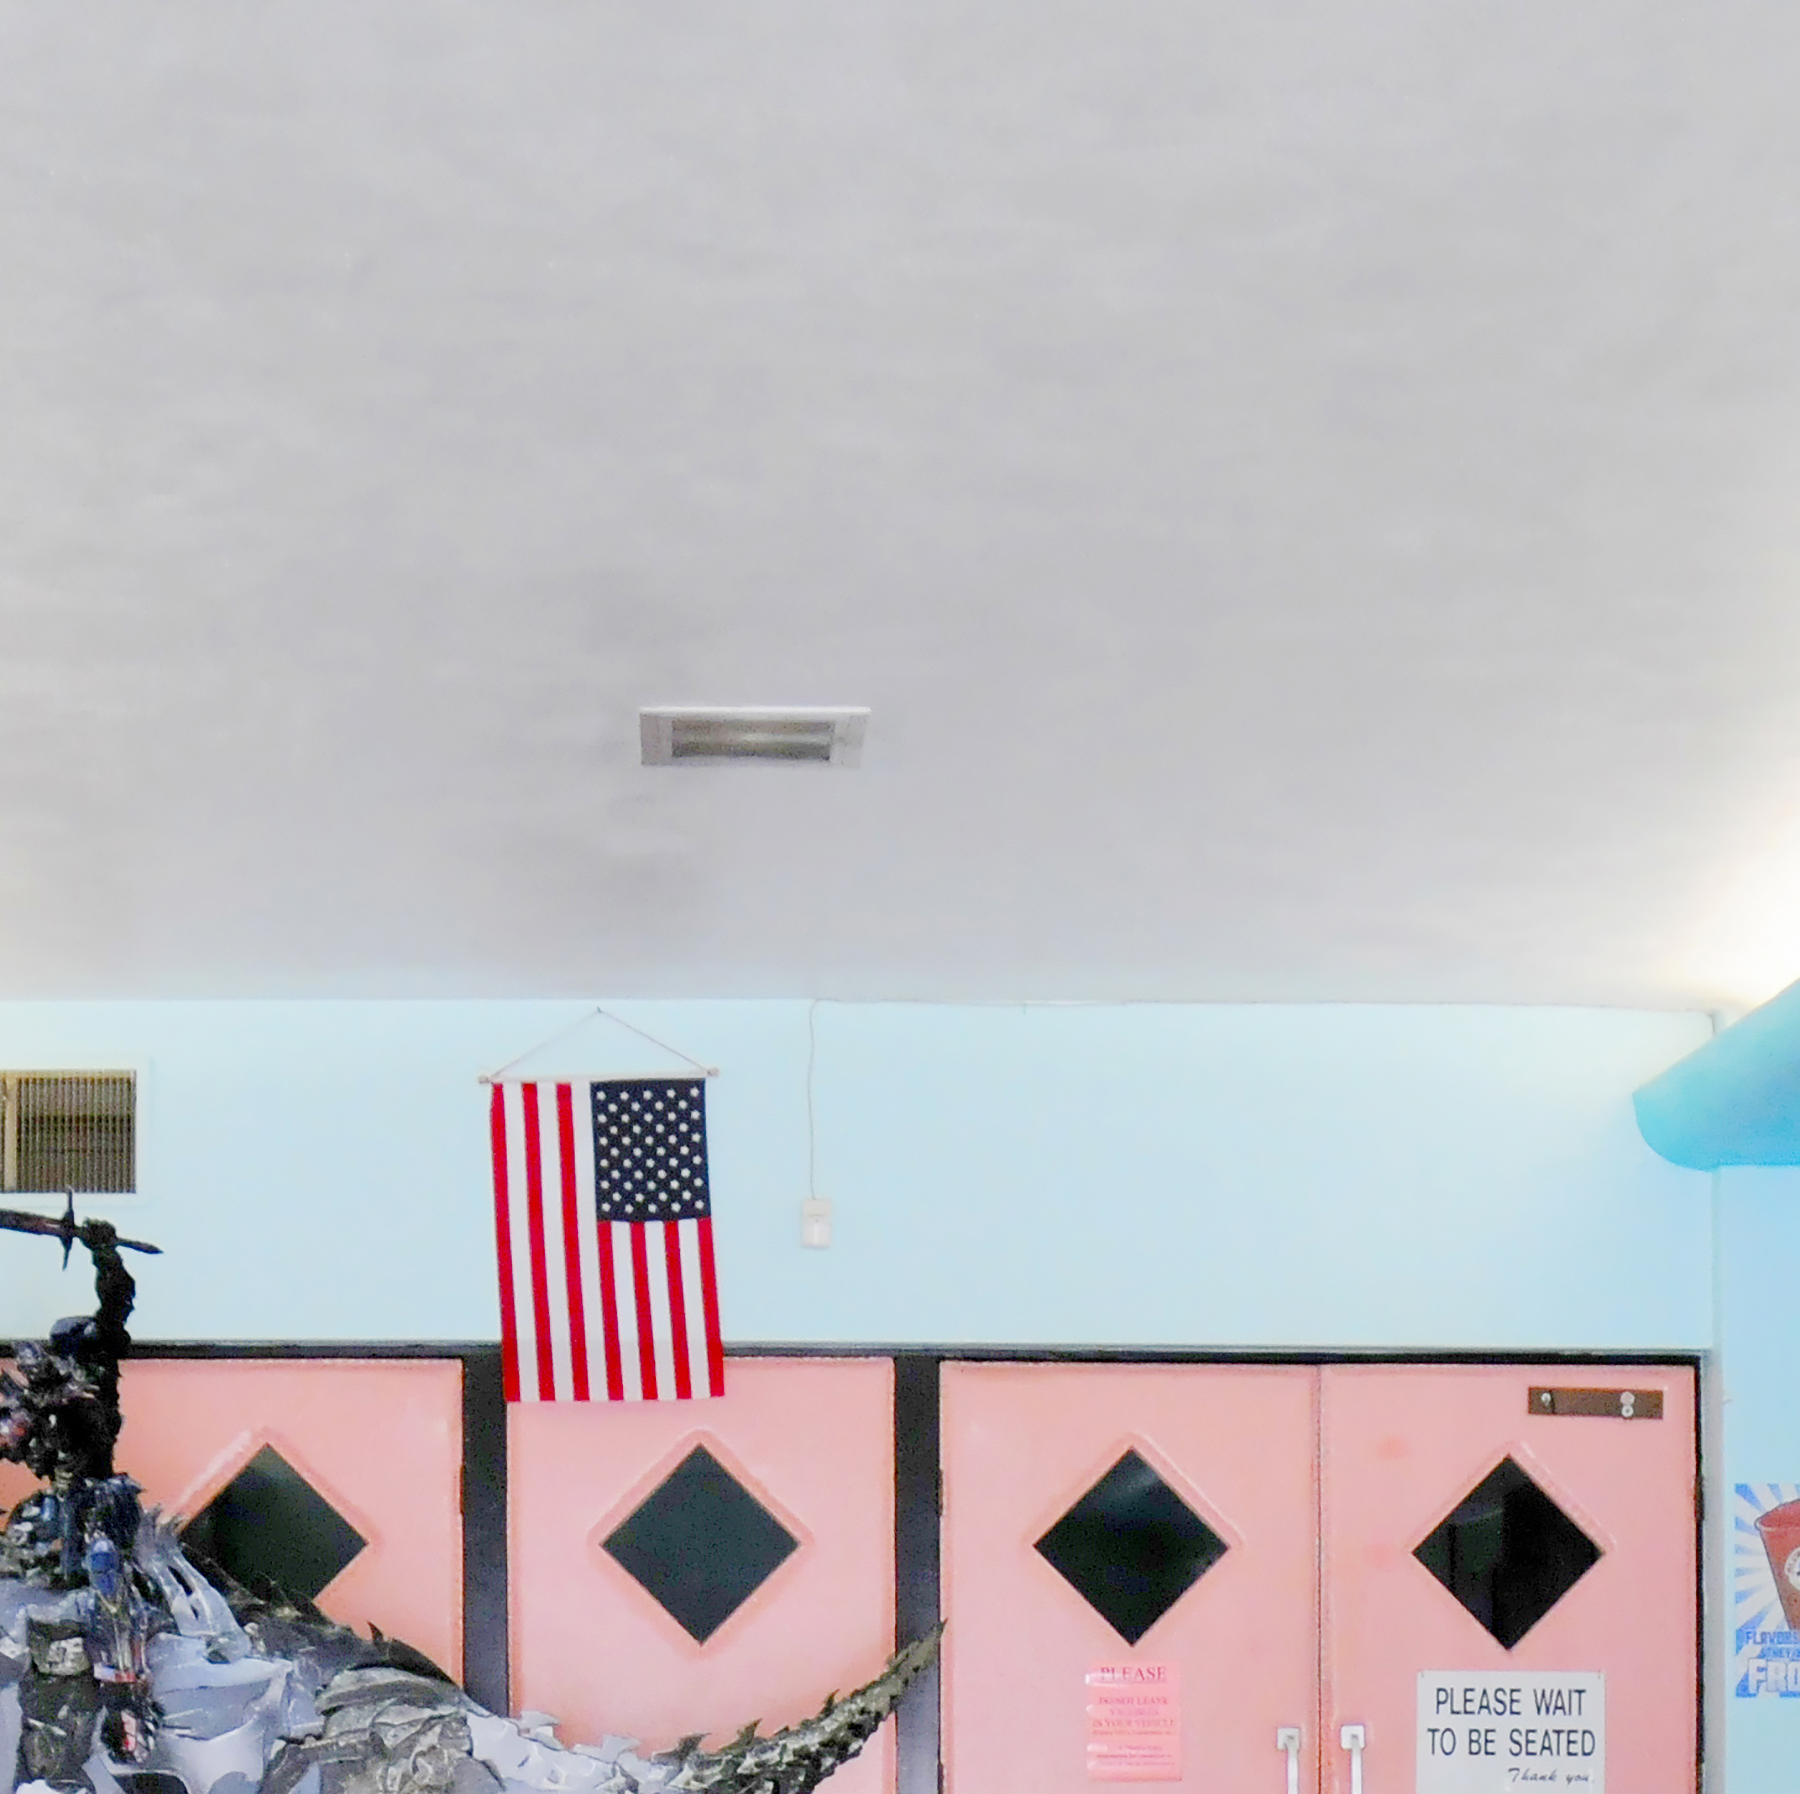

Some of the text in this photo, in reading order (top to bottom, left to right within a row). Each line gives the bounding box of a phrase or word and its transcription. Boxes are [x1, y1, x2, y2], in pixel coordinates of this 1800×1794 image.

[1100, 1666, 1167, 1682] PLEASE
[1435, 1687, 1587, 1716] PLEASE WAIT
[1427, 1727, 1596, 1757] TO BE SEATED
[1507, 1767, 1558, 1783] Thank
